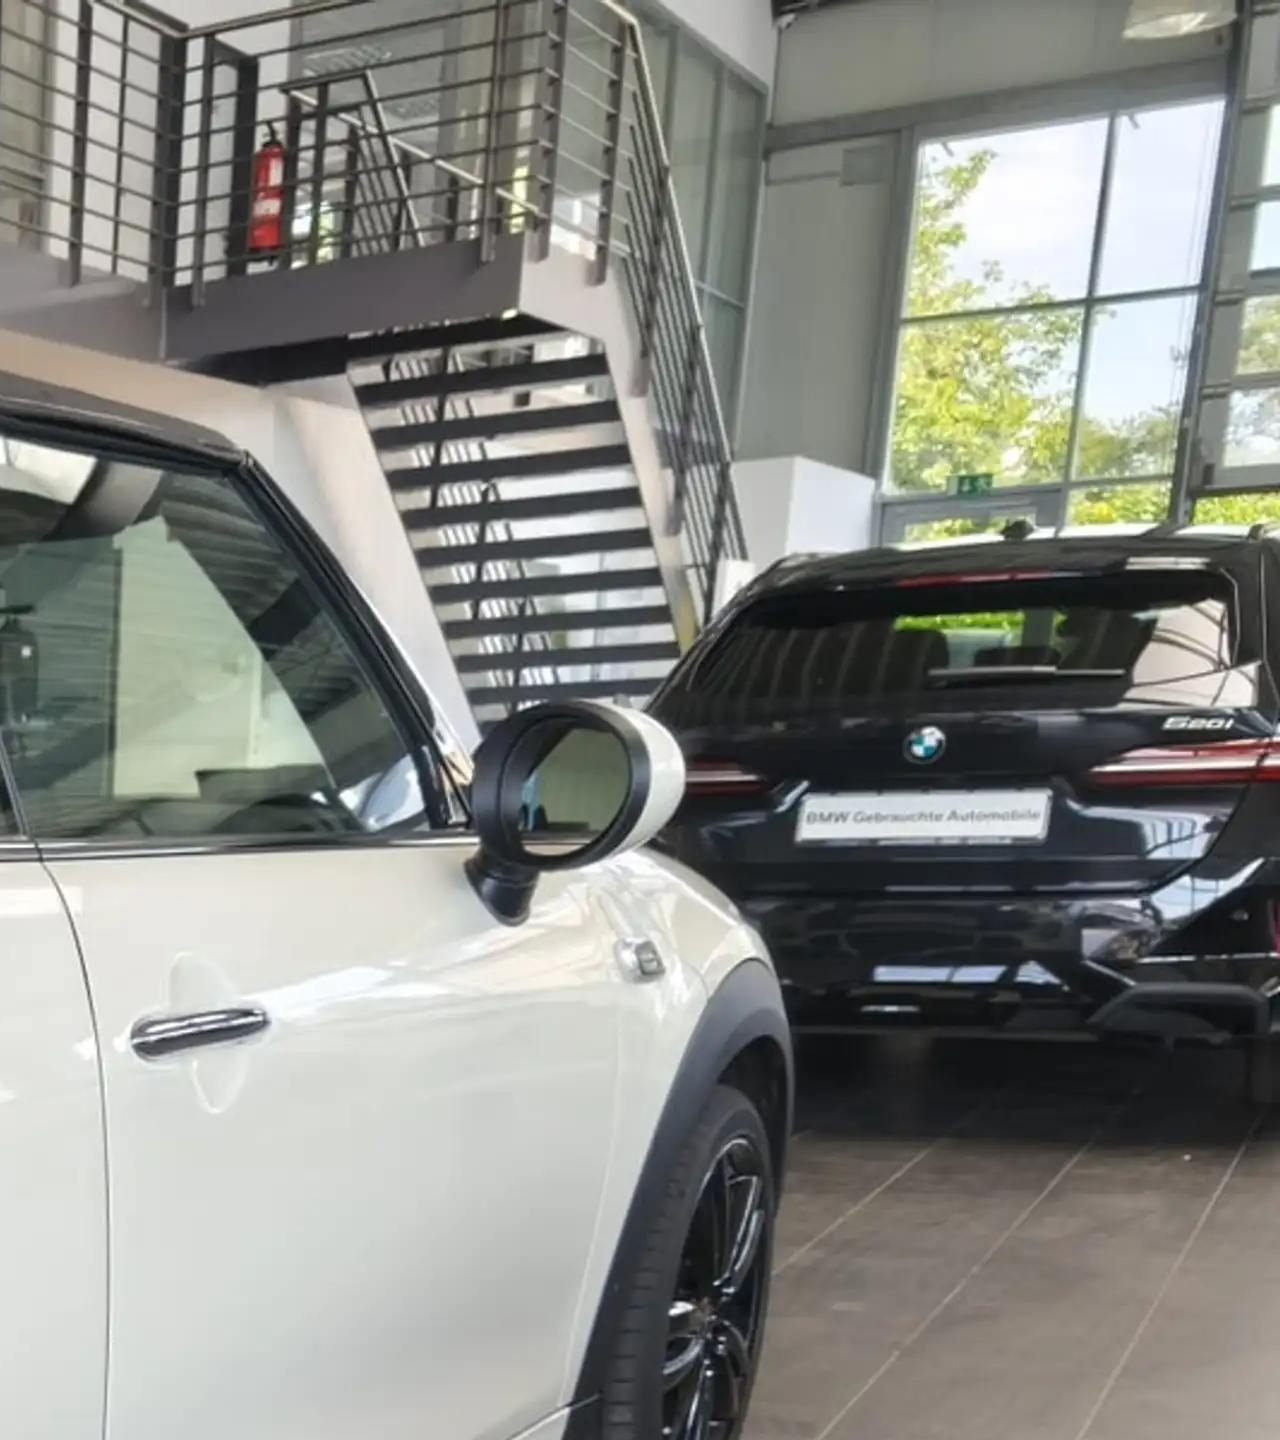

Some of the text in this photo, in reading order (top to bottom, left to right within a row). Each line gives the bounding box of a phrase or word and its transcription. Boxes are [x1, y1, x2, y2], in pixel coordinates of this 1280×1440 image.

[806, 809, 1040, 825] BMW Gebrauchte Automobile
